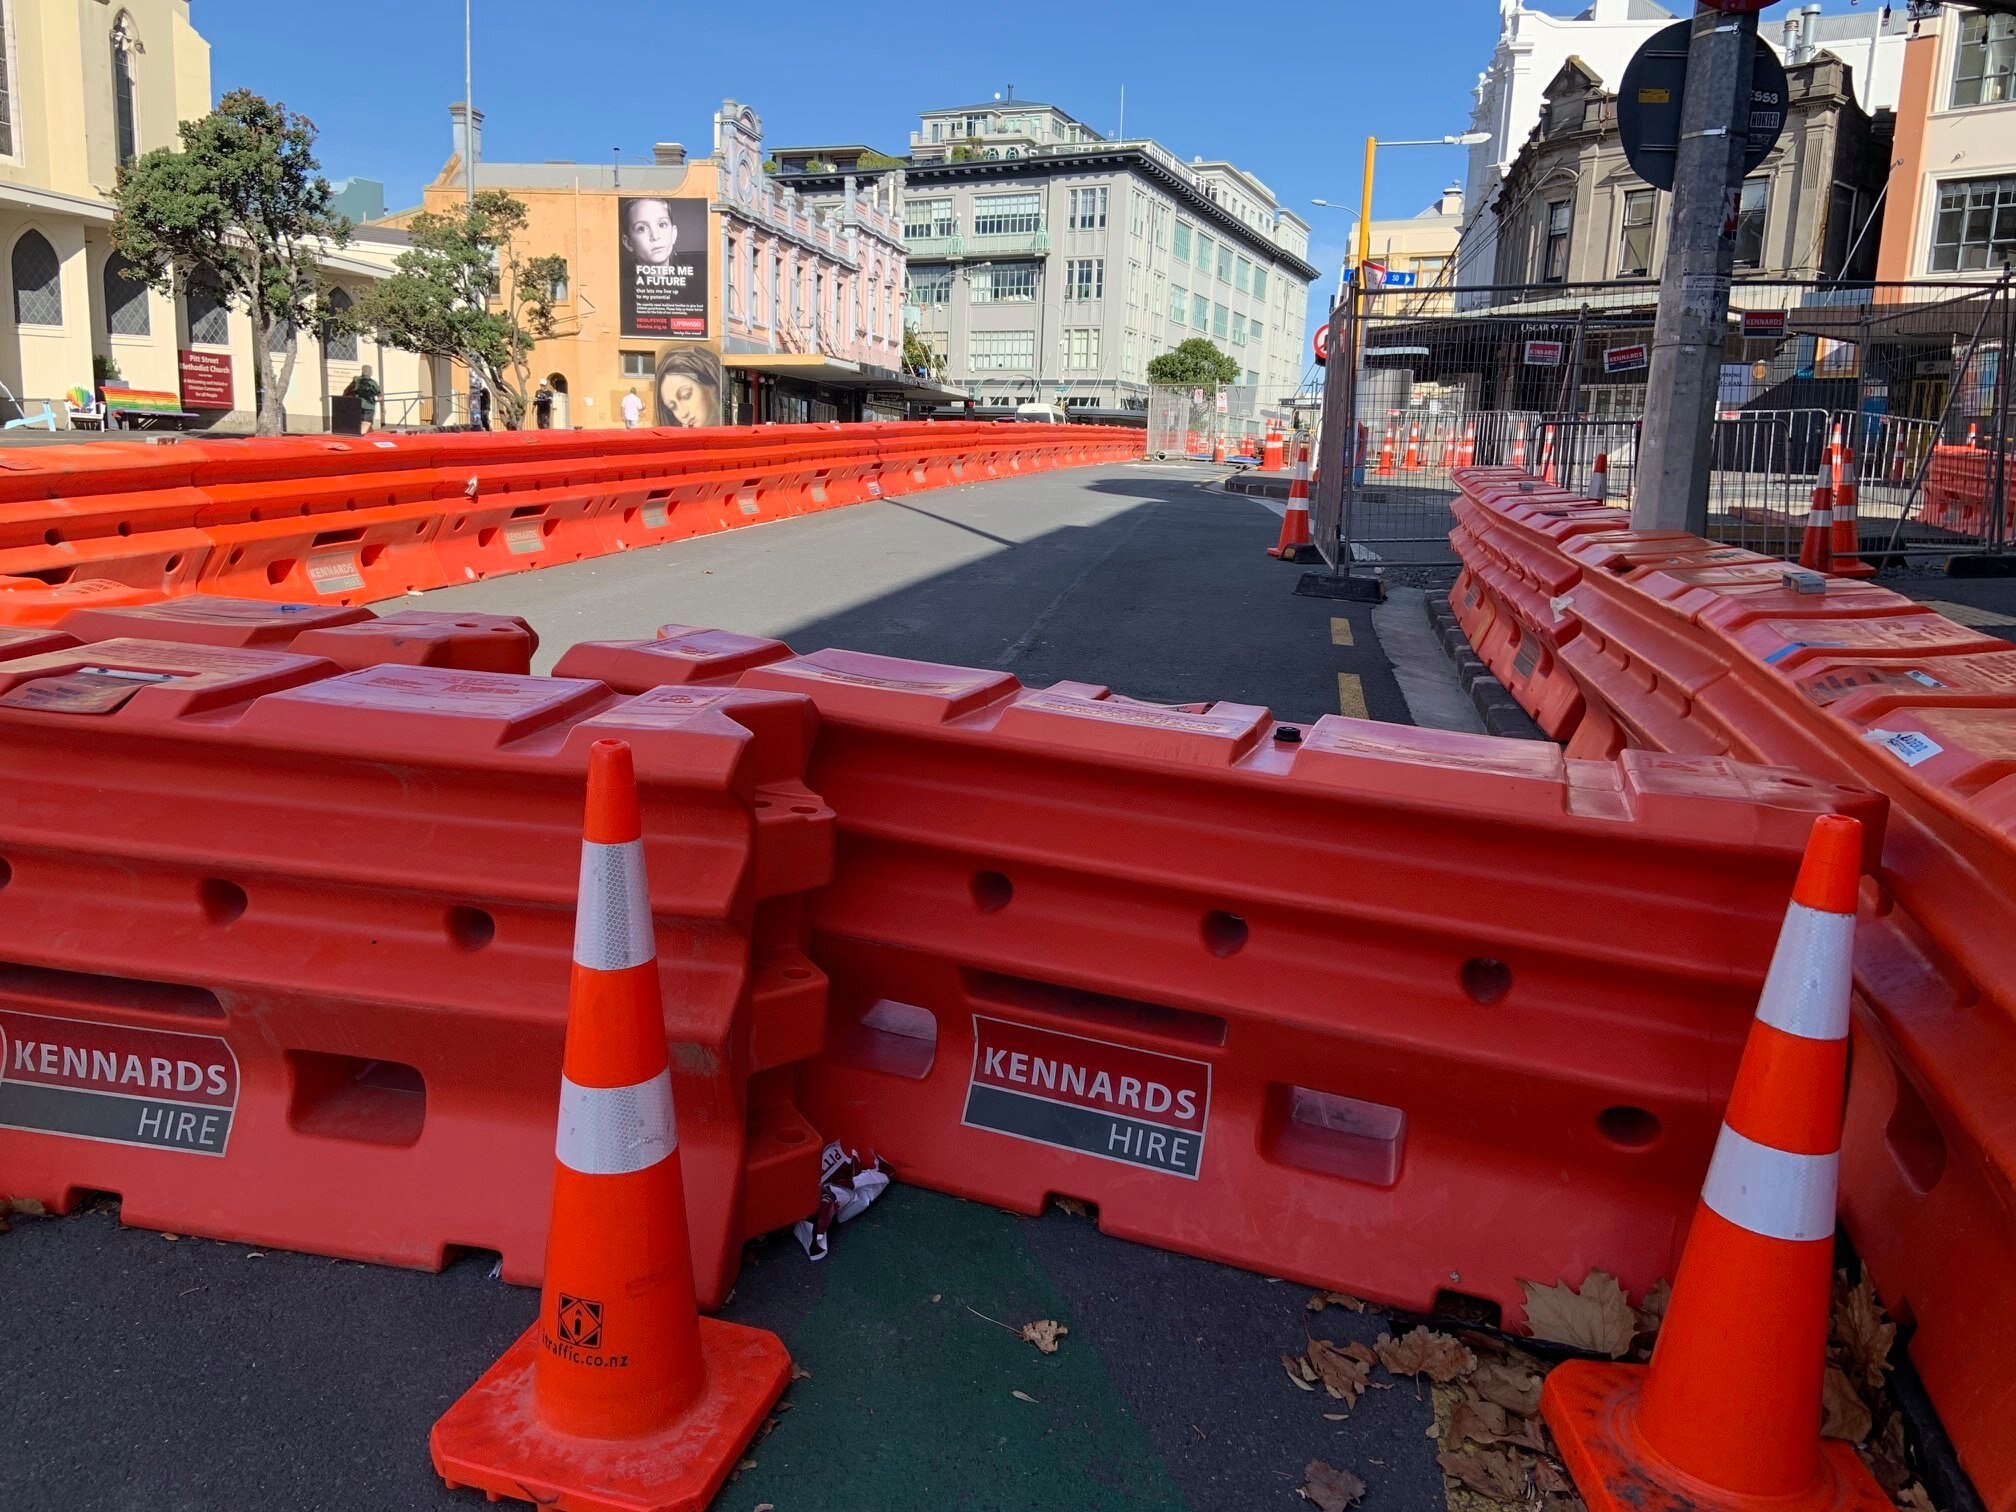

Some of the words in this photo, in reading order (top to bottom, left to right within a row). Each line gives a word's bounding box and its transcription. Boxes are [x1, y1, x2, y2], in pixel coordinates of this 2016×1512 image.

[636, 265, 675, 275] FOSTER
[677, 266, 694, 276] ME
[636, 276, 645, 285] A
[646, 276, 686, 286] FUTURE
[1745, 318, 1783, 326] KENNARDS
[189, 354, 200, 362] Pitt
[201, 355, 219, 364] Street
[1609, 351, 1643, 363] KENNARDS
[210, 365, 230, 374] Church
[309, 563, 355, 579] KENNARDS
[343, 576, 362, 588] HIRE
[14, 1039, 228, 1096] KENNARDS
[983, 1046, 1197, 1120] KENNARDS
[137, 1107, 220, 1145] HIRE
[1108, 1122, 1190, 1167] HIRE
